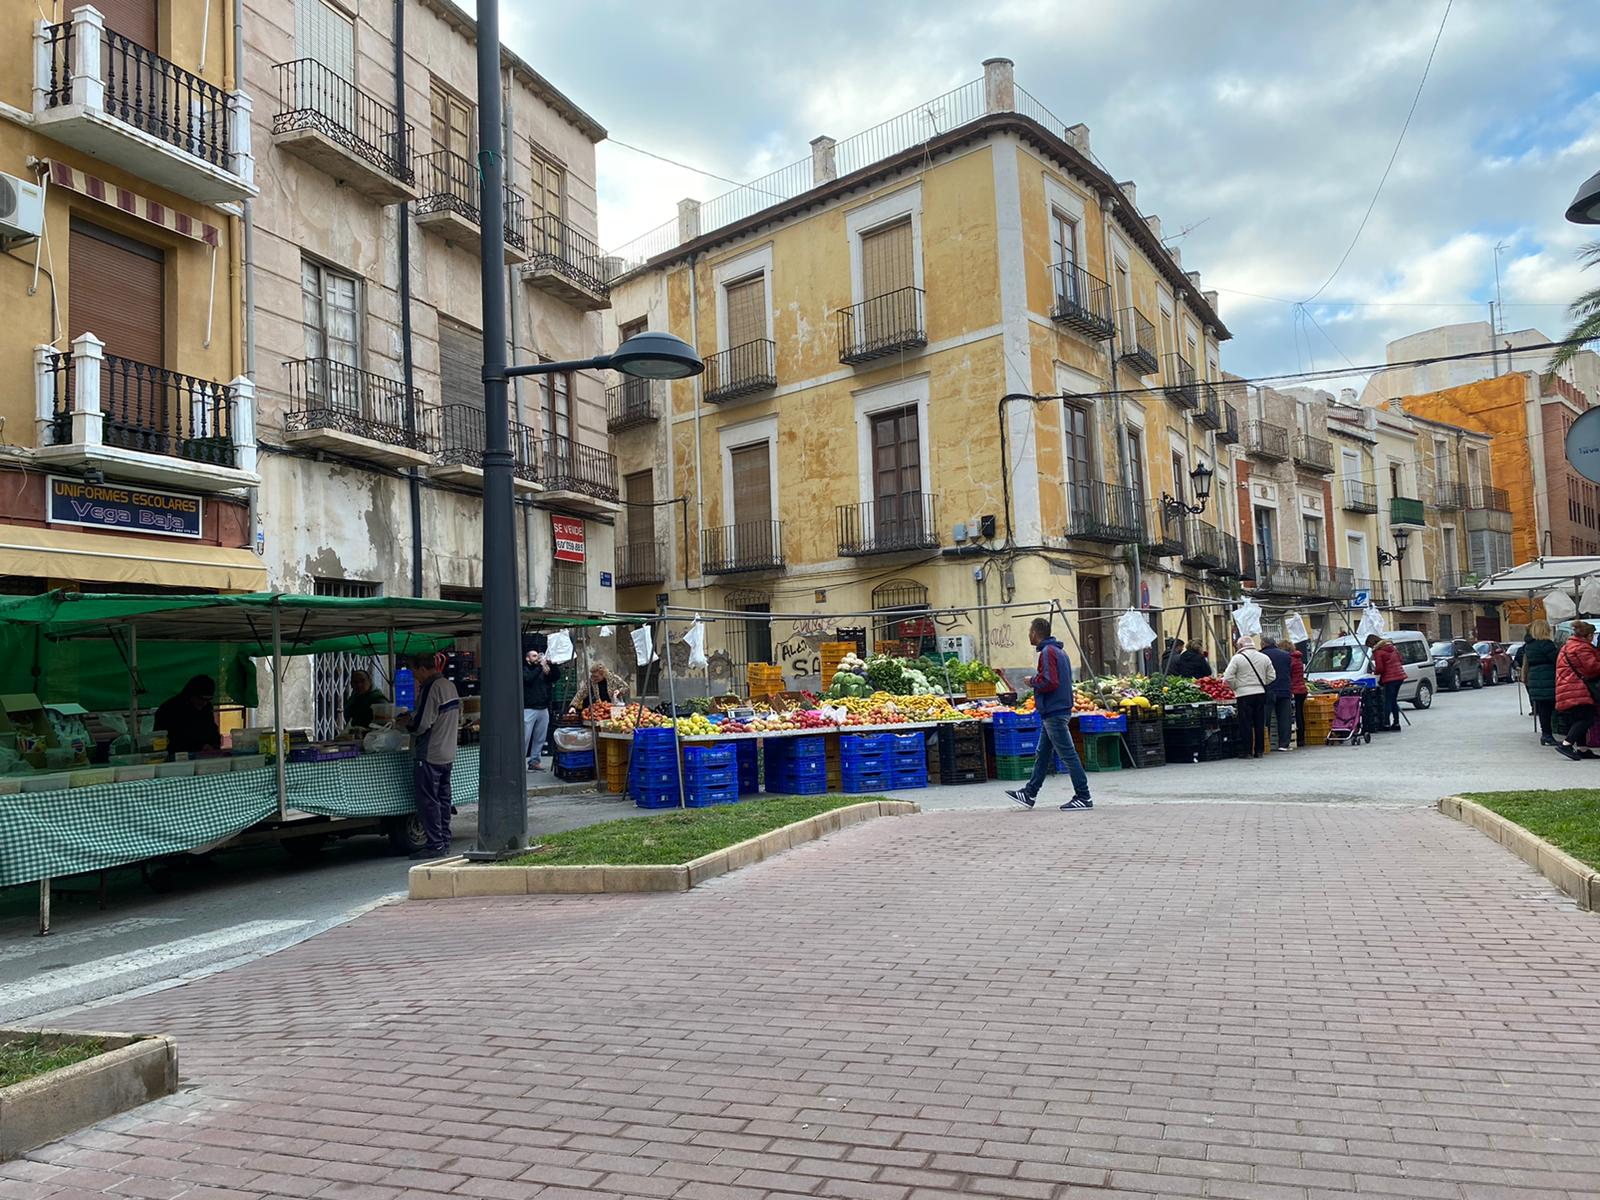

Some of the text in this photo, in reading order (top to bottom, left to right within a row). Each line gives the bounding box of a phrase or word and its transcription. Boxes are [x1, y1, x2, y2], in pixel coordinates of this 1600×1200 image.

[54, 482, 197, 512] UNIFORMES ESCOLARES
[70, 500, 184, 529] Vega Baja
[553, 523, 583, 537] SE VENDE
